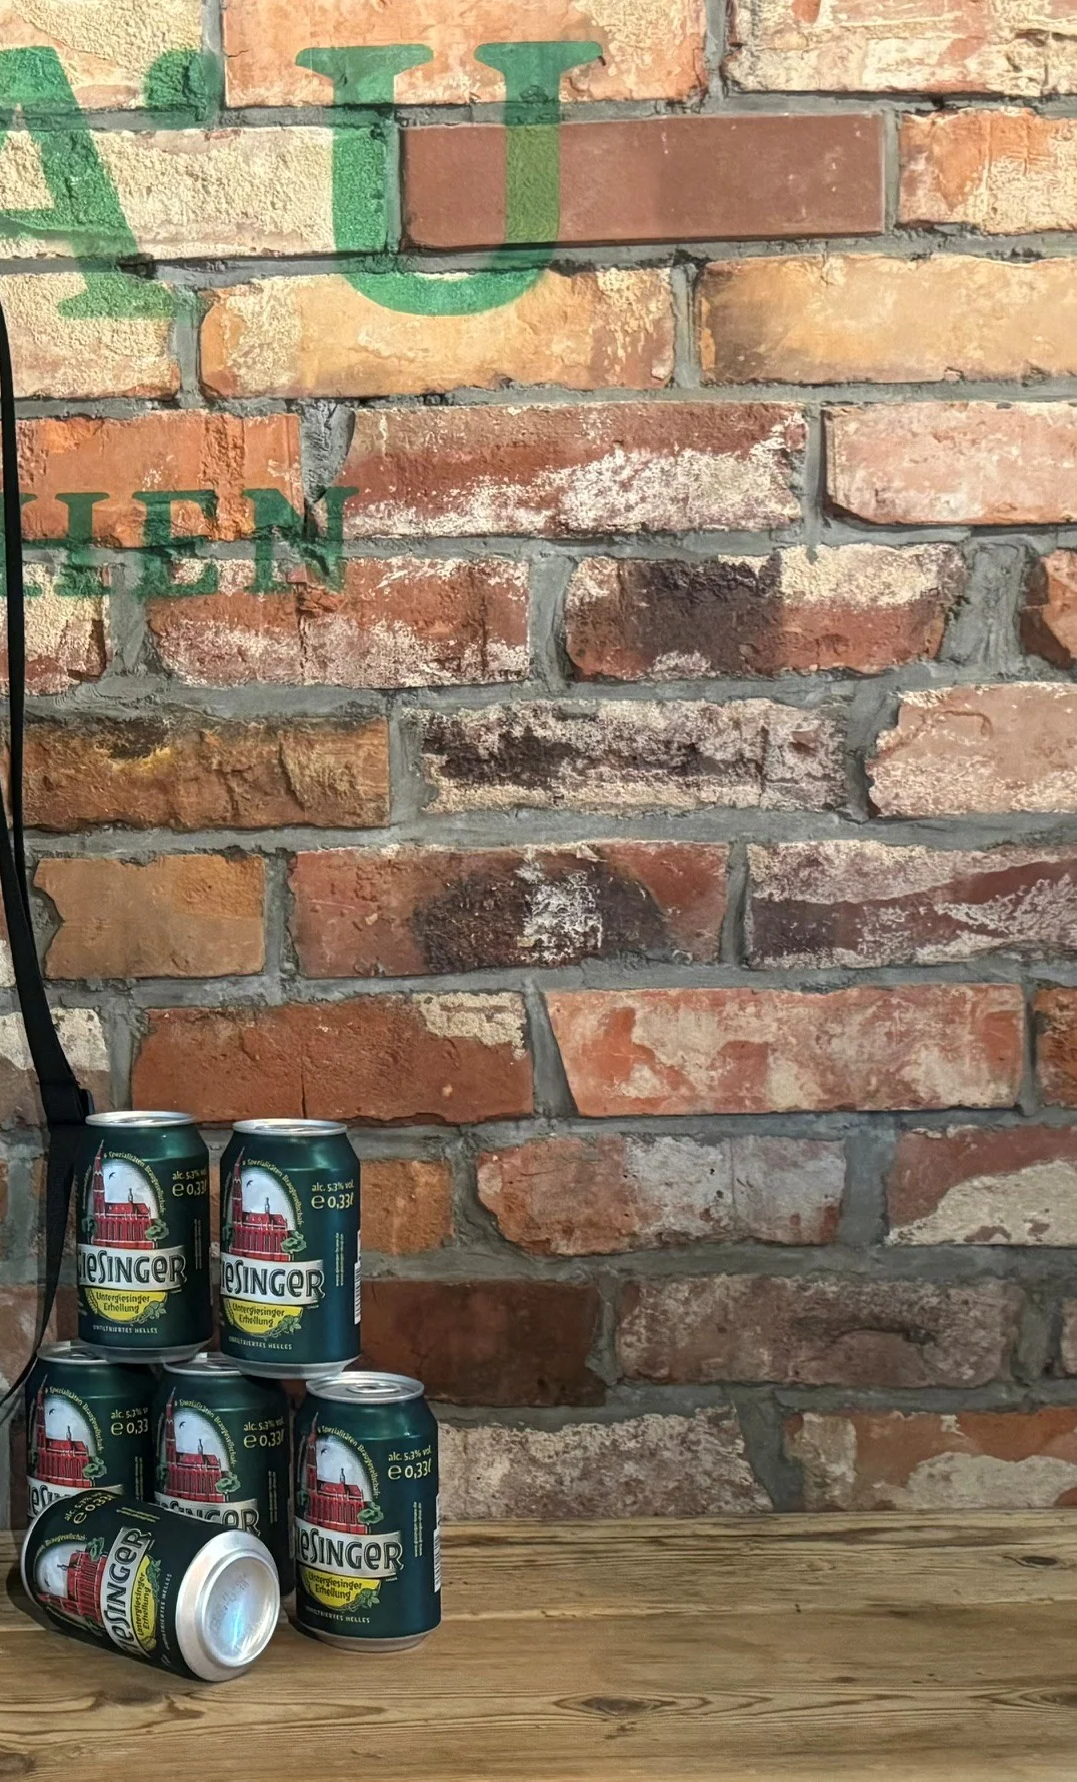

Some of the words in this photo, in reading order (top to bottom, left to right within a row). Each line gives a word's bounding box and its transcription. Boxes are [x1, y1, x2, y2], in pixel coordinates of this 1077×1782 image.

[96, 1291, 150, 1303] Untergiesinger
[103, 1303, 140, 1313] Erhellung
[232, 1303, 285, 1317] Untergiesinger
[239, 1314, 274, 1327] Erhellung
